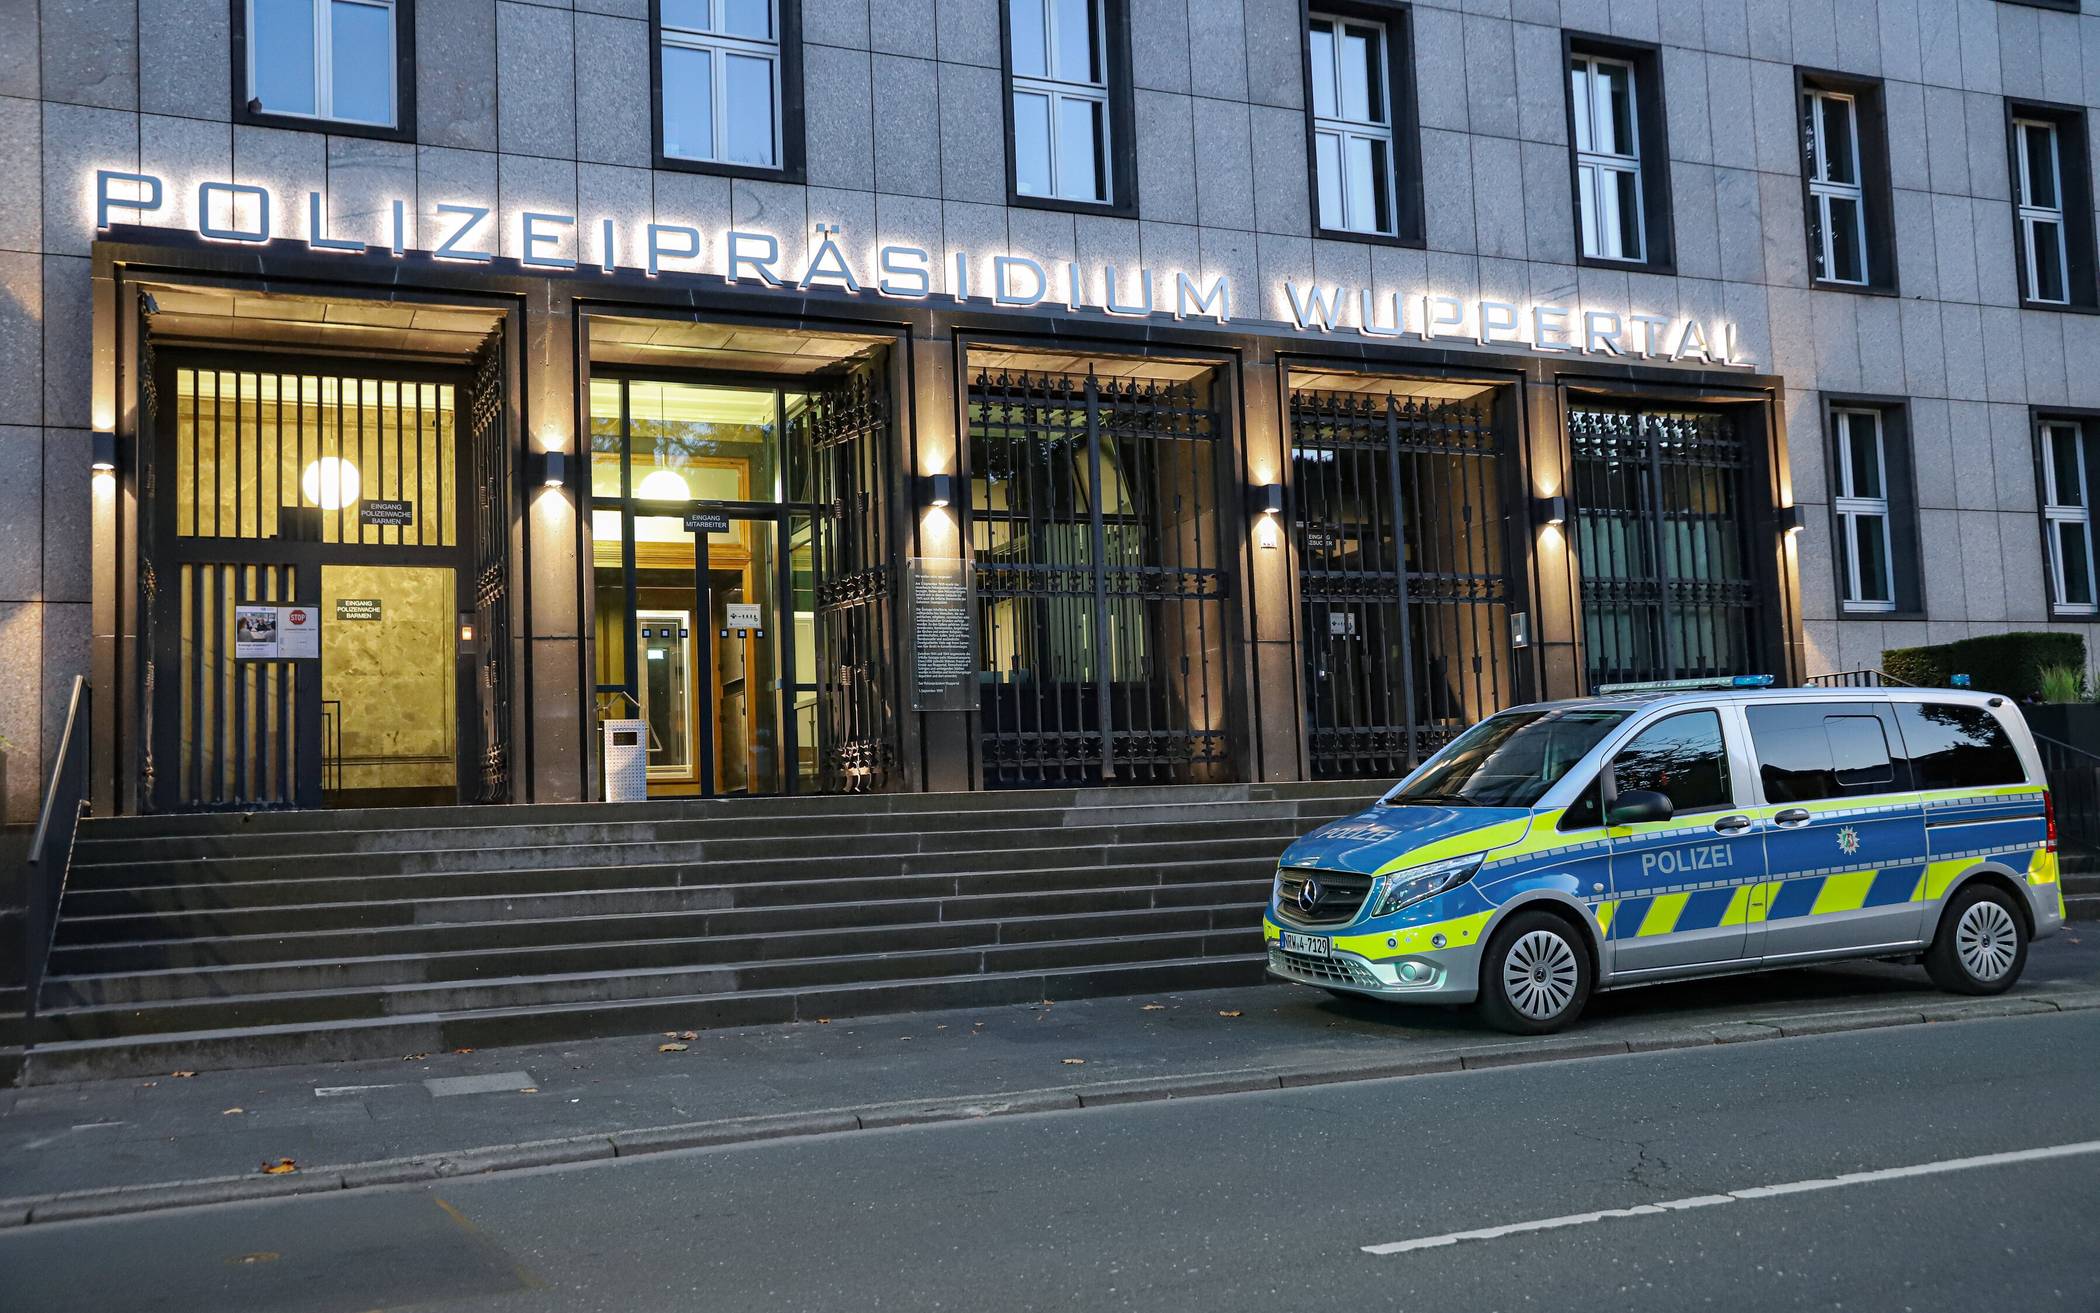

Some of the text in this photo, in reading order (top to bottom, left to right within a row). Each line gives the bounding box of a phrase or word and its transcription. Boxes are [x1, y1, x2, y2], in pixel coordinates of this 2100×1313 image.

[96, 169, 1754, 366] POLIZEIPRÄSIDIUM WUPPERTAL
[361, 510, 412, 518] POLIZEIWACHE
[371, 517, 402, 525] BARMEN
[290, 613, 305, 621] STOP
[1315, 826, 1402, 842] POLIZEI
[1641, 843, 1733, 876] POLIZEI
